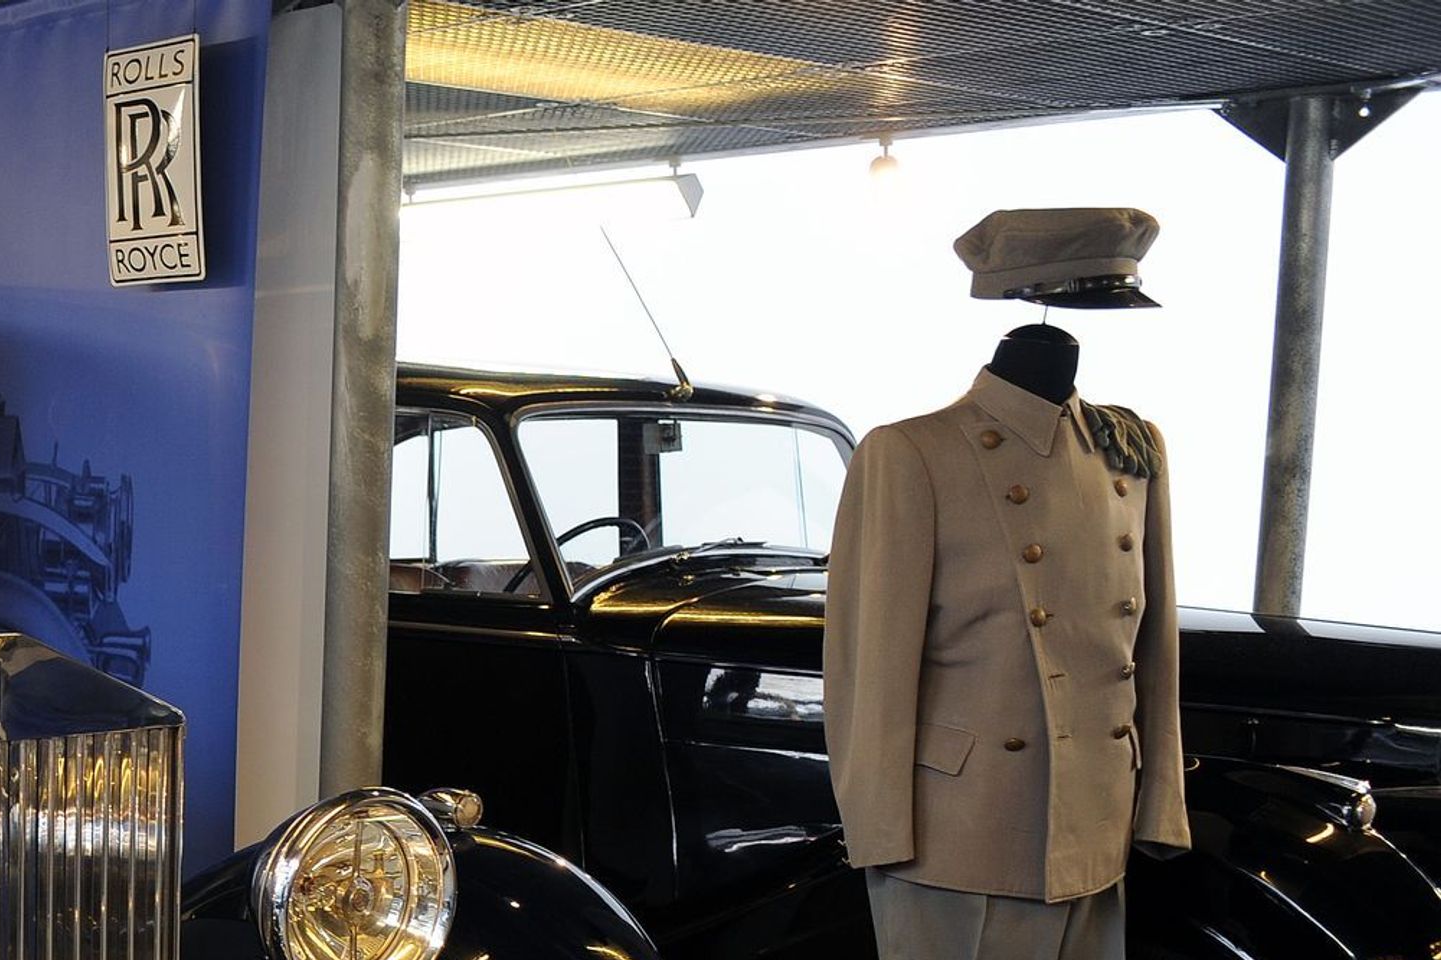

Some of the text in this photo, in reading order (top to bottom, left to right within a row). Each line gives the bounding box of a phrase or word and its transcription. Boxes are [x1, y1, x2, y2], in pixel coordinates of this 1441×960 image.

[111, 50, 185, 88] ROLLS
[114, 98, 186, 231] RR
[116, 243, 192, 273] ROYCE
